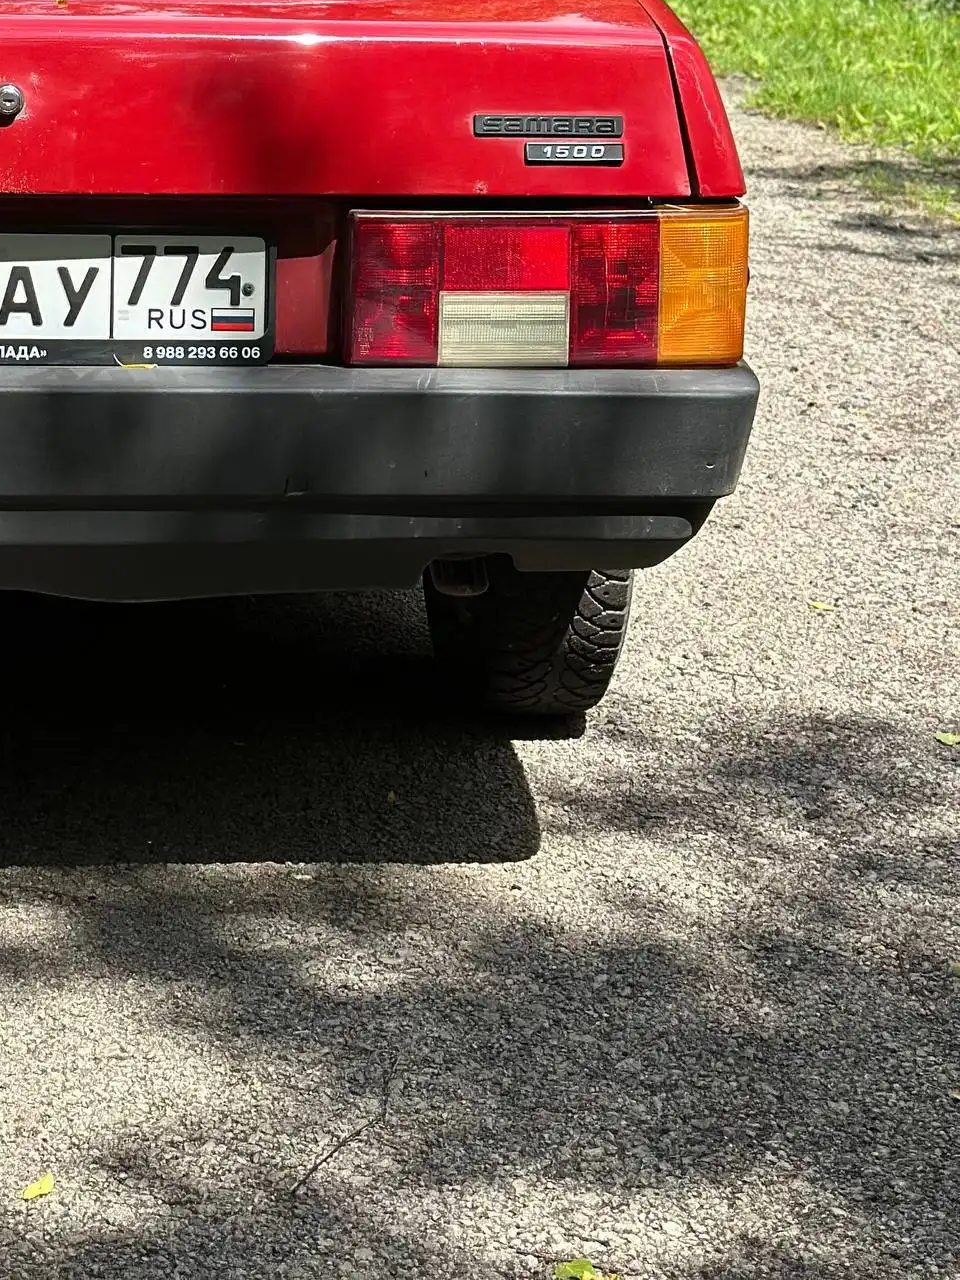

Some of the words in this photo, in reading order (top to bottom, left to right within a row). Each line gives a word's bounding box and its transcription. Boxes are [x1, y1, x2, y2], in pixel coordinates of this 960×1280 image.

[543, 145, 605, 159] 1500
[121, 245, 241, 306] 774
[147, 308, 208, 330] RUS
[142, 346, 154, 359] 8
[155, 346, 186, 359] 988
[187, 346, 217, 359] 293
[219, 346, 239, 359] 66
[241, 346, 261, 359] 06
